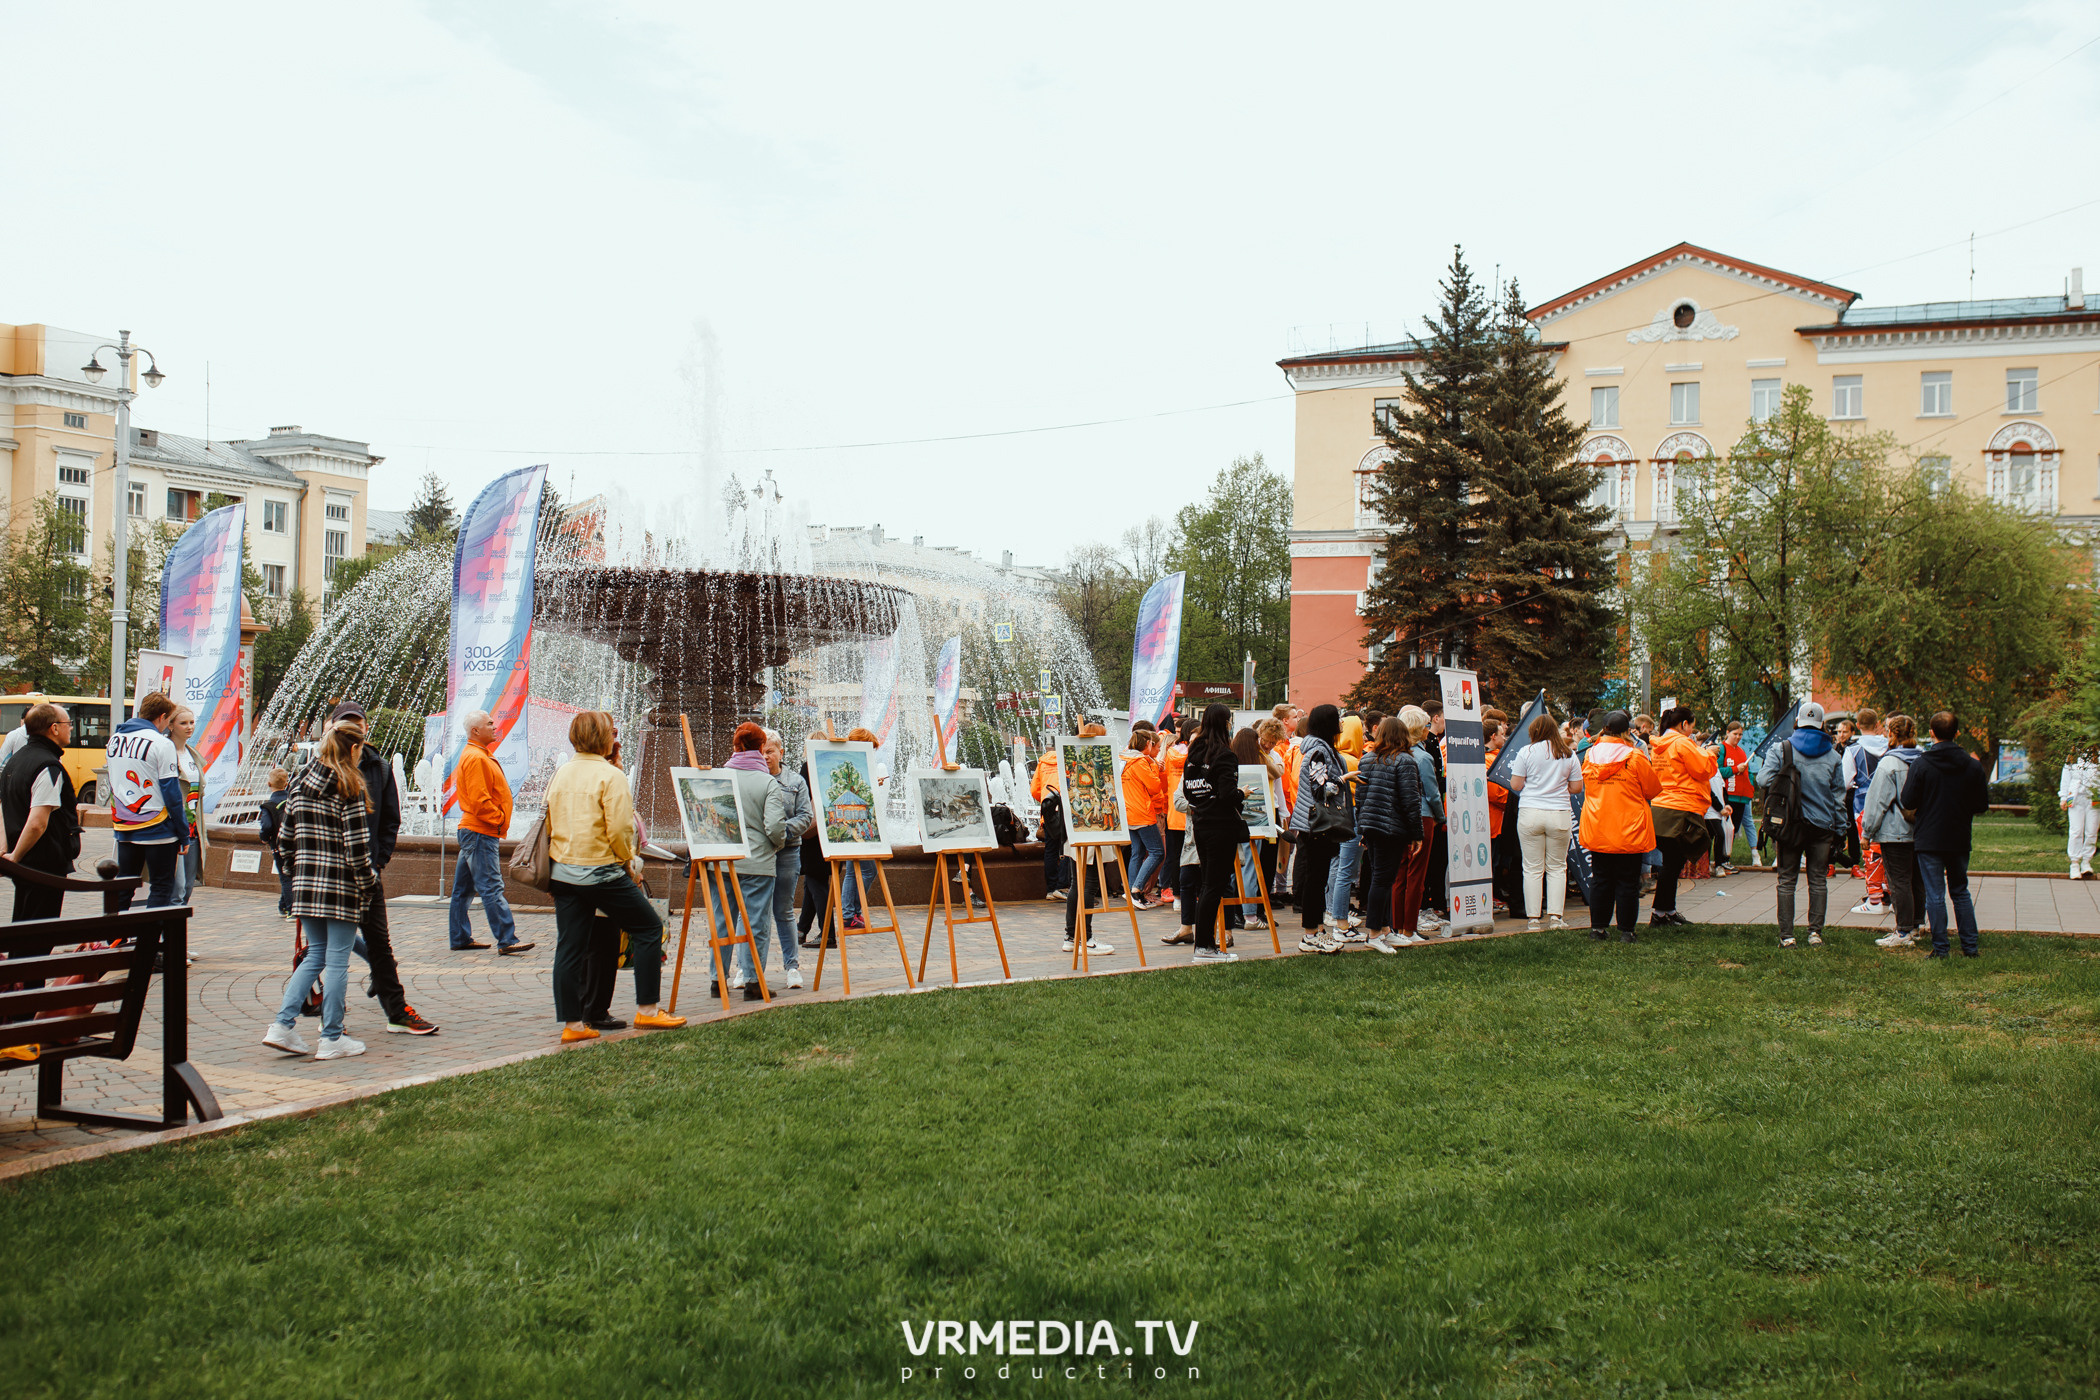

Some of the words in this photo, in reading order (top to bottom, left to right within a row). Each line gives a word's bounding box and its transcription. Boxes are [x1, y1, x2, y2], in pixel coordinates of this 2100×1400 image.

[464, 646, 492, 659] 300
[463, 659, 529, 672] КУЗБАССУ
[185, 677, 200, 689] 00
[185, 687, 237, 701] ЗБАССУ
[1139, 687, 1157, 697] 300
[1204, 686, 1232, 694] АФИША
